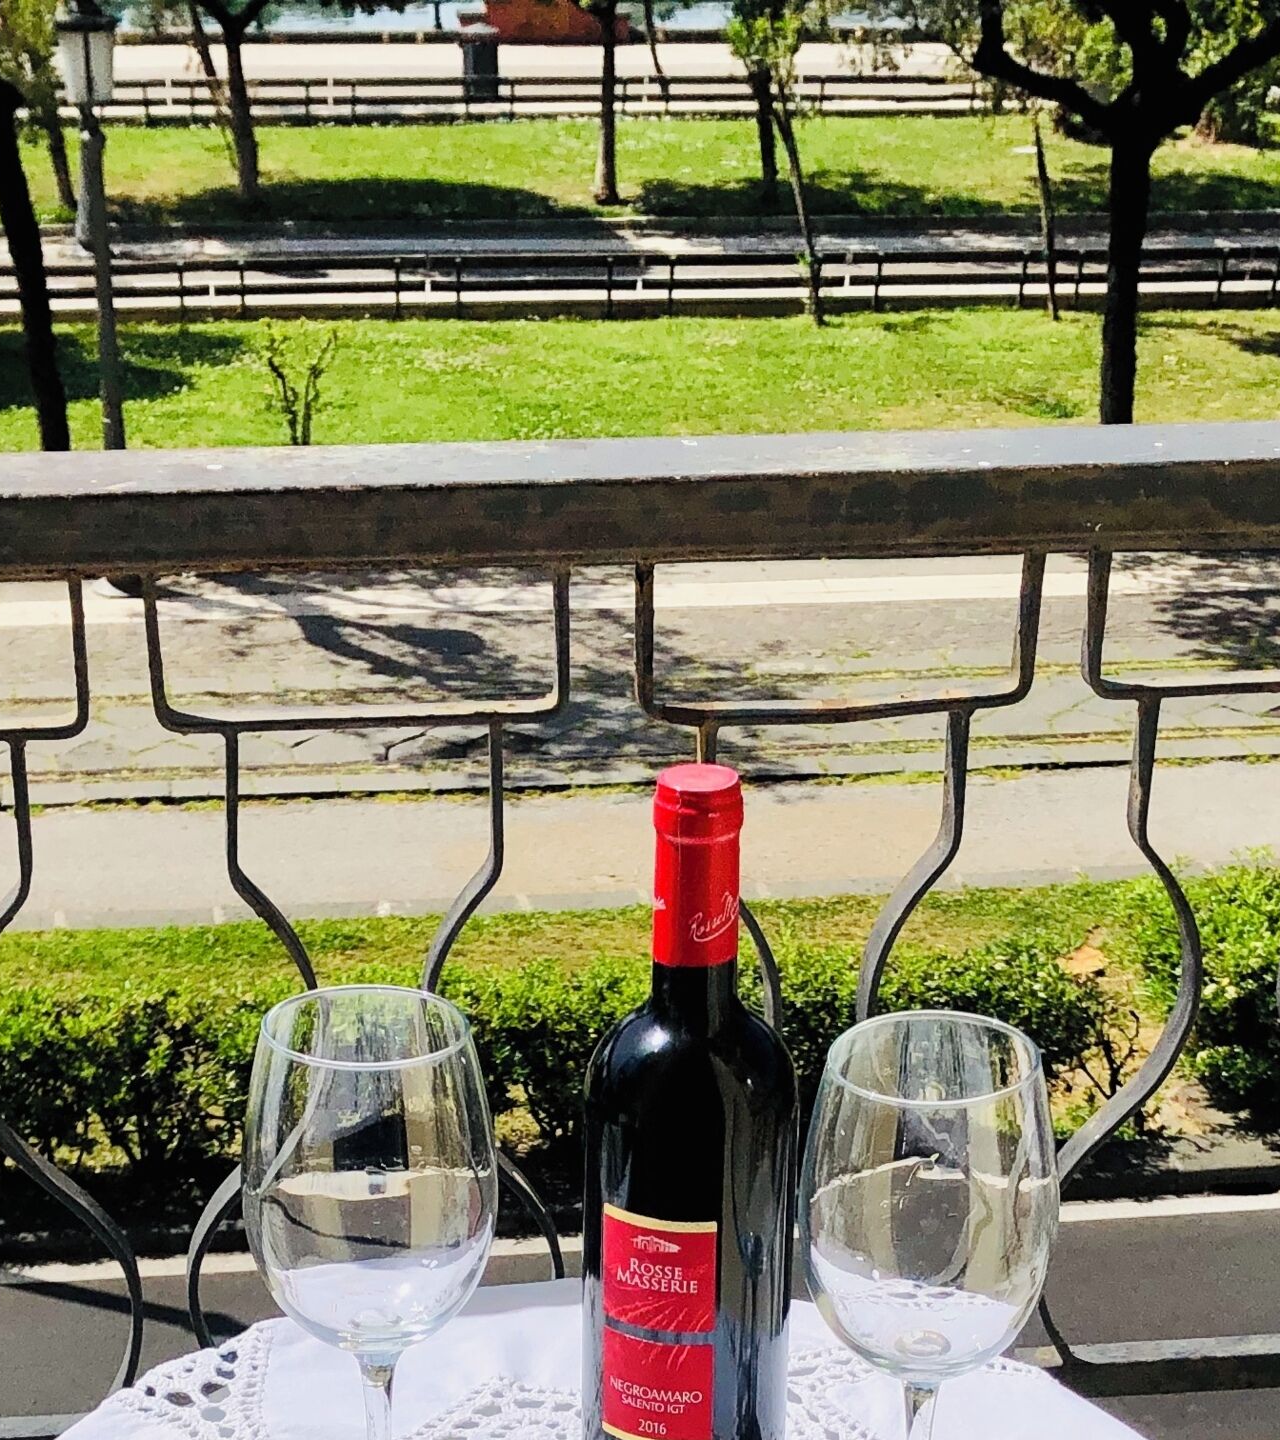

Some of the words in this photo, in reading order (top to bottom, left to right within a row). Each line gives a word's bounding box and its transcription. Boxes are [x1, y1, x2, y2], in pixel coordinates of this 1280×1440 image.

[616, 1268, 698, 1294] MASSERIE
[629, 1257, 683, 1281] ROSSE
[609, 1376, 702, 1404] NEGROAMARO
[621, 1393, 664, 1413] SALENTO
[667, 1402, 685, 1414] IGT
[638, 1418, 667, 1435] 2016
